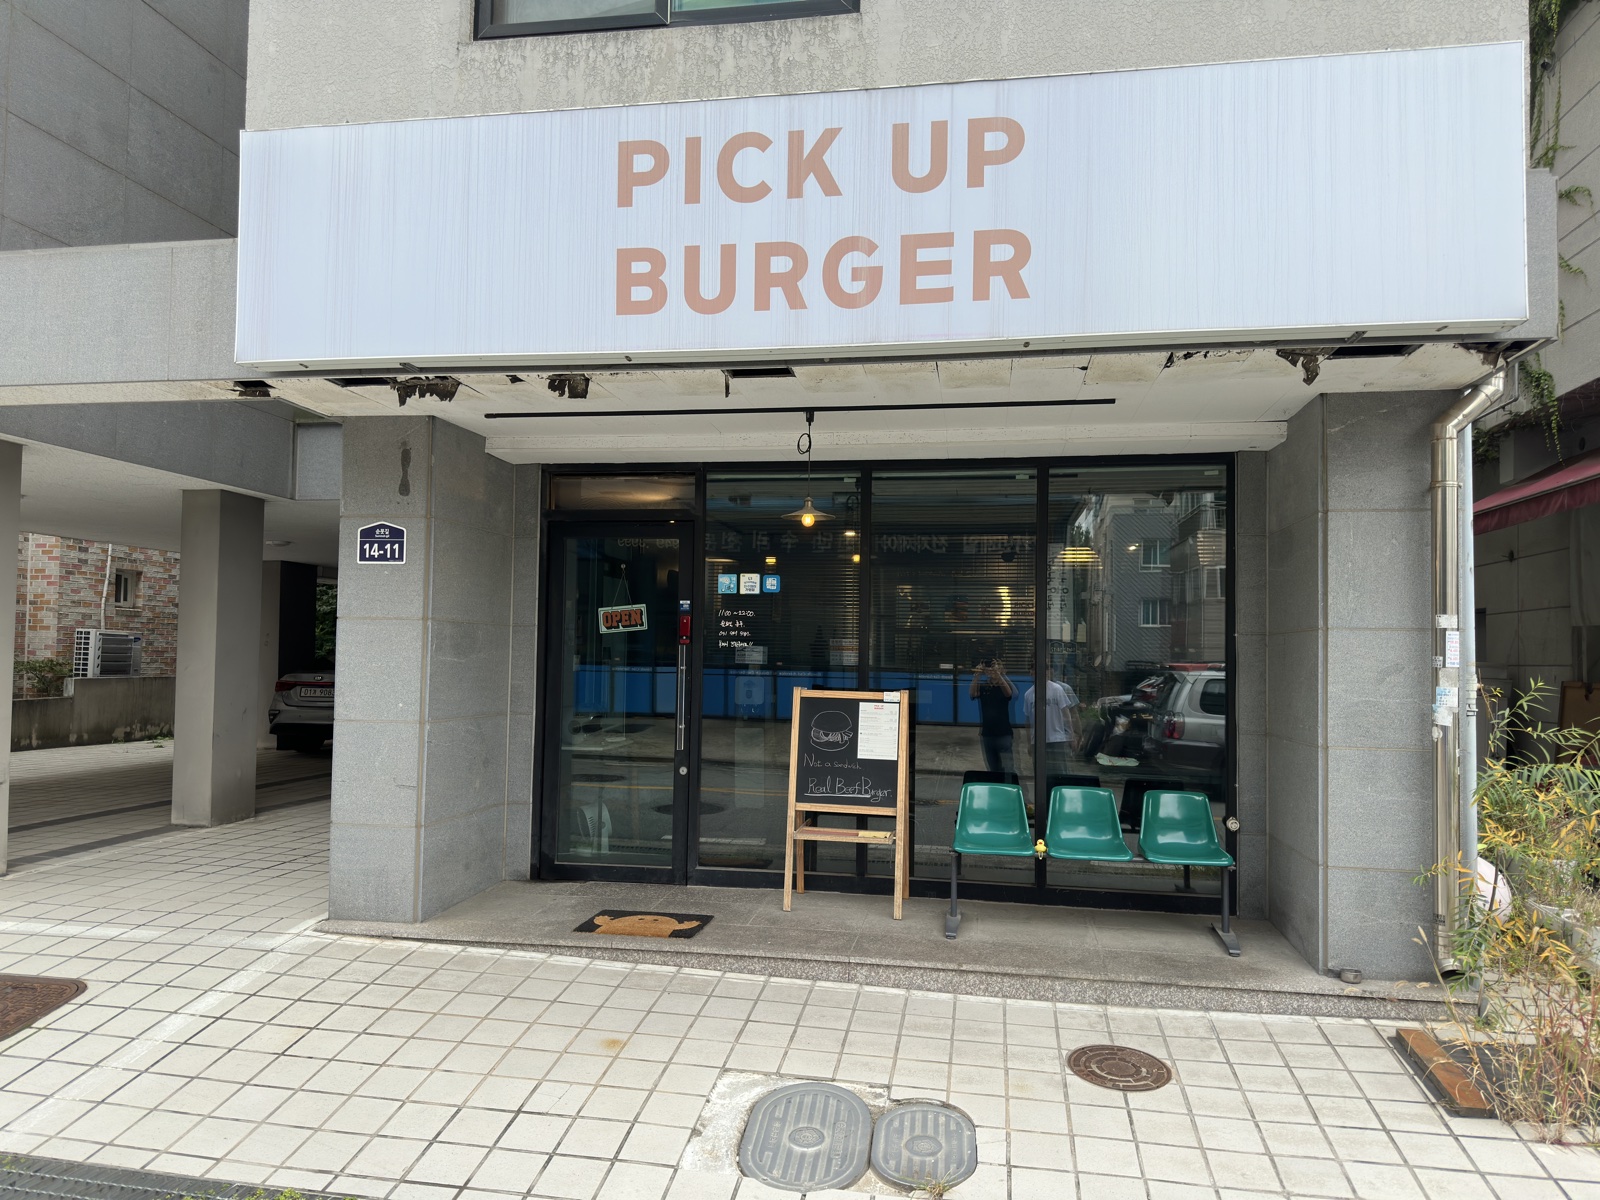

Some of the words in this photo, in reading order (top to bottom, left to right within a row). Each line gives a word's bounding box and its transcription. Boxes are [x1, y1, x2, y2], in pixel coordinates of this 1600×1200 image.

[617, 127, 844, 208] PICK
[891, 116, 1026, 194] UP
[616, 228, 1032, 316] BURGER
[363, 543, 399, 558] 14-11
[602, 608, 644, 630] OPEN
[804, 753, 822, 767] Not
[808, 776, 832, 794] Real
[836, 777, 860, 795] Beef
